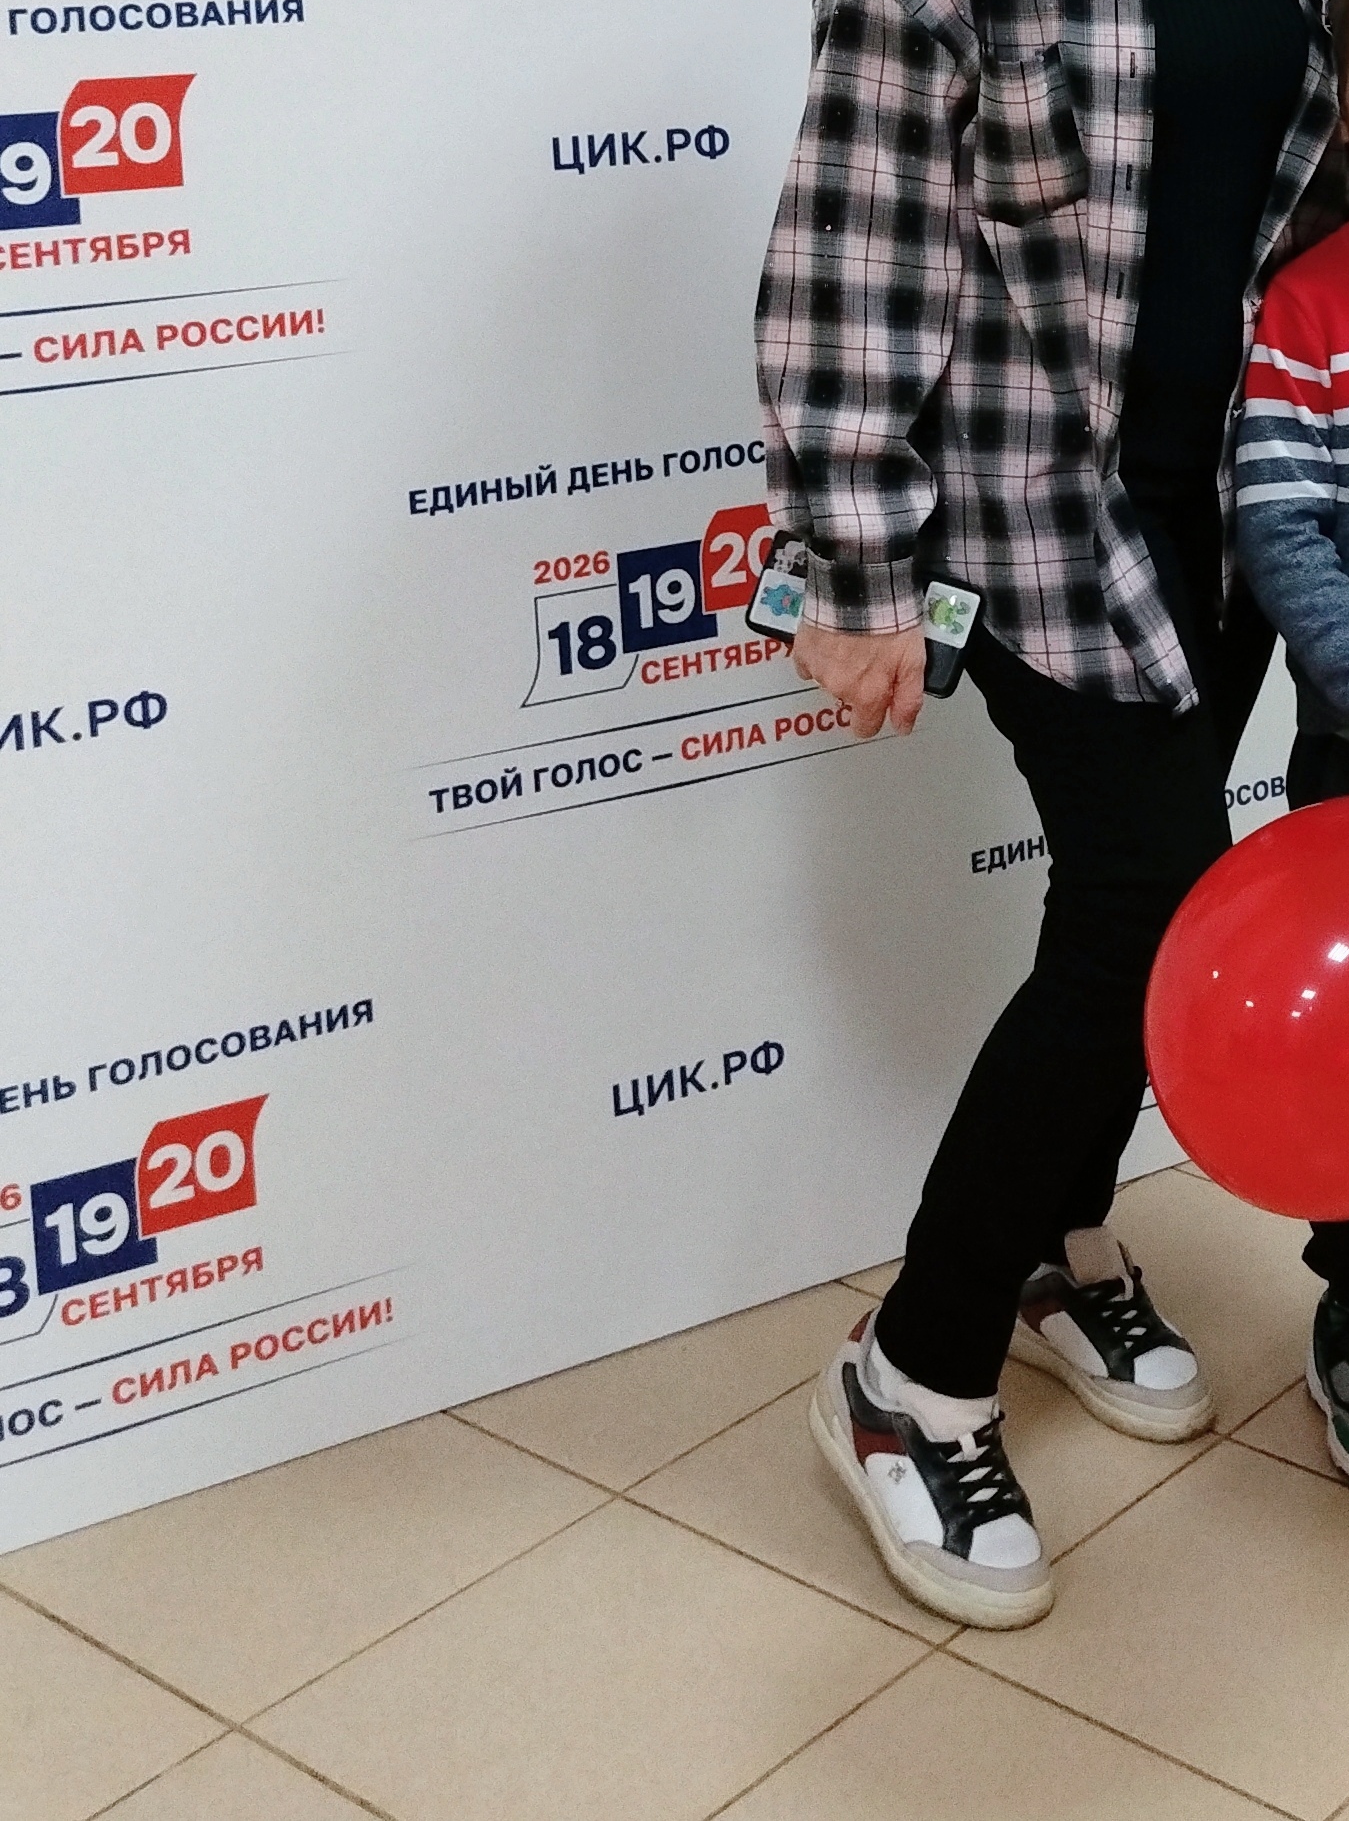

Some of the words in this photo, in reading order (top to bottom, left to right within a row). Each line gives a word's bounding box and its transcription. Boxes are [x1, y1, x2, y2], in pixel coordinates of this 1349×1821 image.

[0, 141, 52, 206] 9
[70, 101, 172, 169] 20
[552, 124, 730, 175] ЦИК.РФ
[33, 328, 145, 364] СИЛА
[156, 308, 325, 351] РОССИИ!
[408, 464, 558, 517] ЕДИНЫЙ
[567, 457, 654, 496] ДЕНЬ
[663, 440, 767, 477] ГОЛОС
[532, 550, 611, 585] 2026
[548, 615, 616, 674] 18
[627, 567, 695, 628] 19
[0, 690, 168, 752] ИК.РФ
[428, 768, 523, 814] ТВОЙ
[532, 749, 643, 793] ГОЛОС
[680, 718, 767, 761] СИЛА
[775, 704, 852, 742] РОСС
[970, 834, 1046, 875] ЕДИН
[0, 1075, 77, 1115] ЕНЬ
[87, 998, 374, 1093] ГОЛОСОВАНИЯ
[612, 1040, 785, 1117] ЦИК.РФ
[44, 1192, 130, 1267] 19
[148, 1129, 246, 1209] 20
[60, 1245, 265, 1327] СЕНТЯБРЯ
[0, 1399, 63, 1442] ОС
[111, 1353, 219, 1405] СИЛА
[230, 1297, 394, 1370] РОССИИ!
